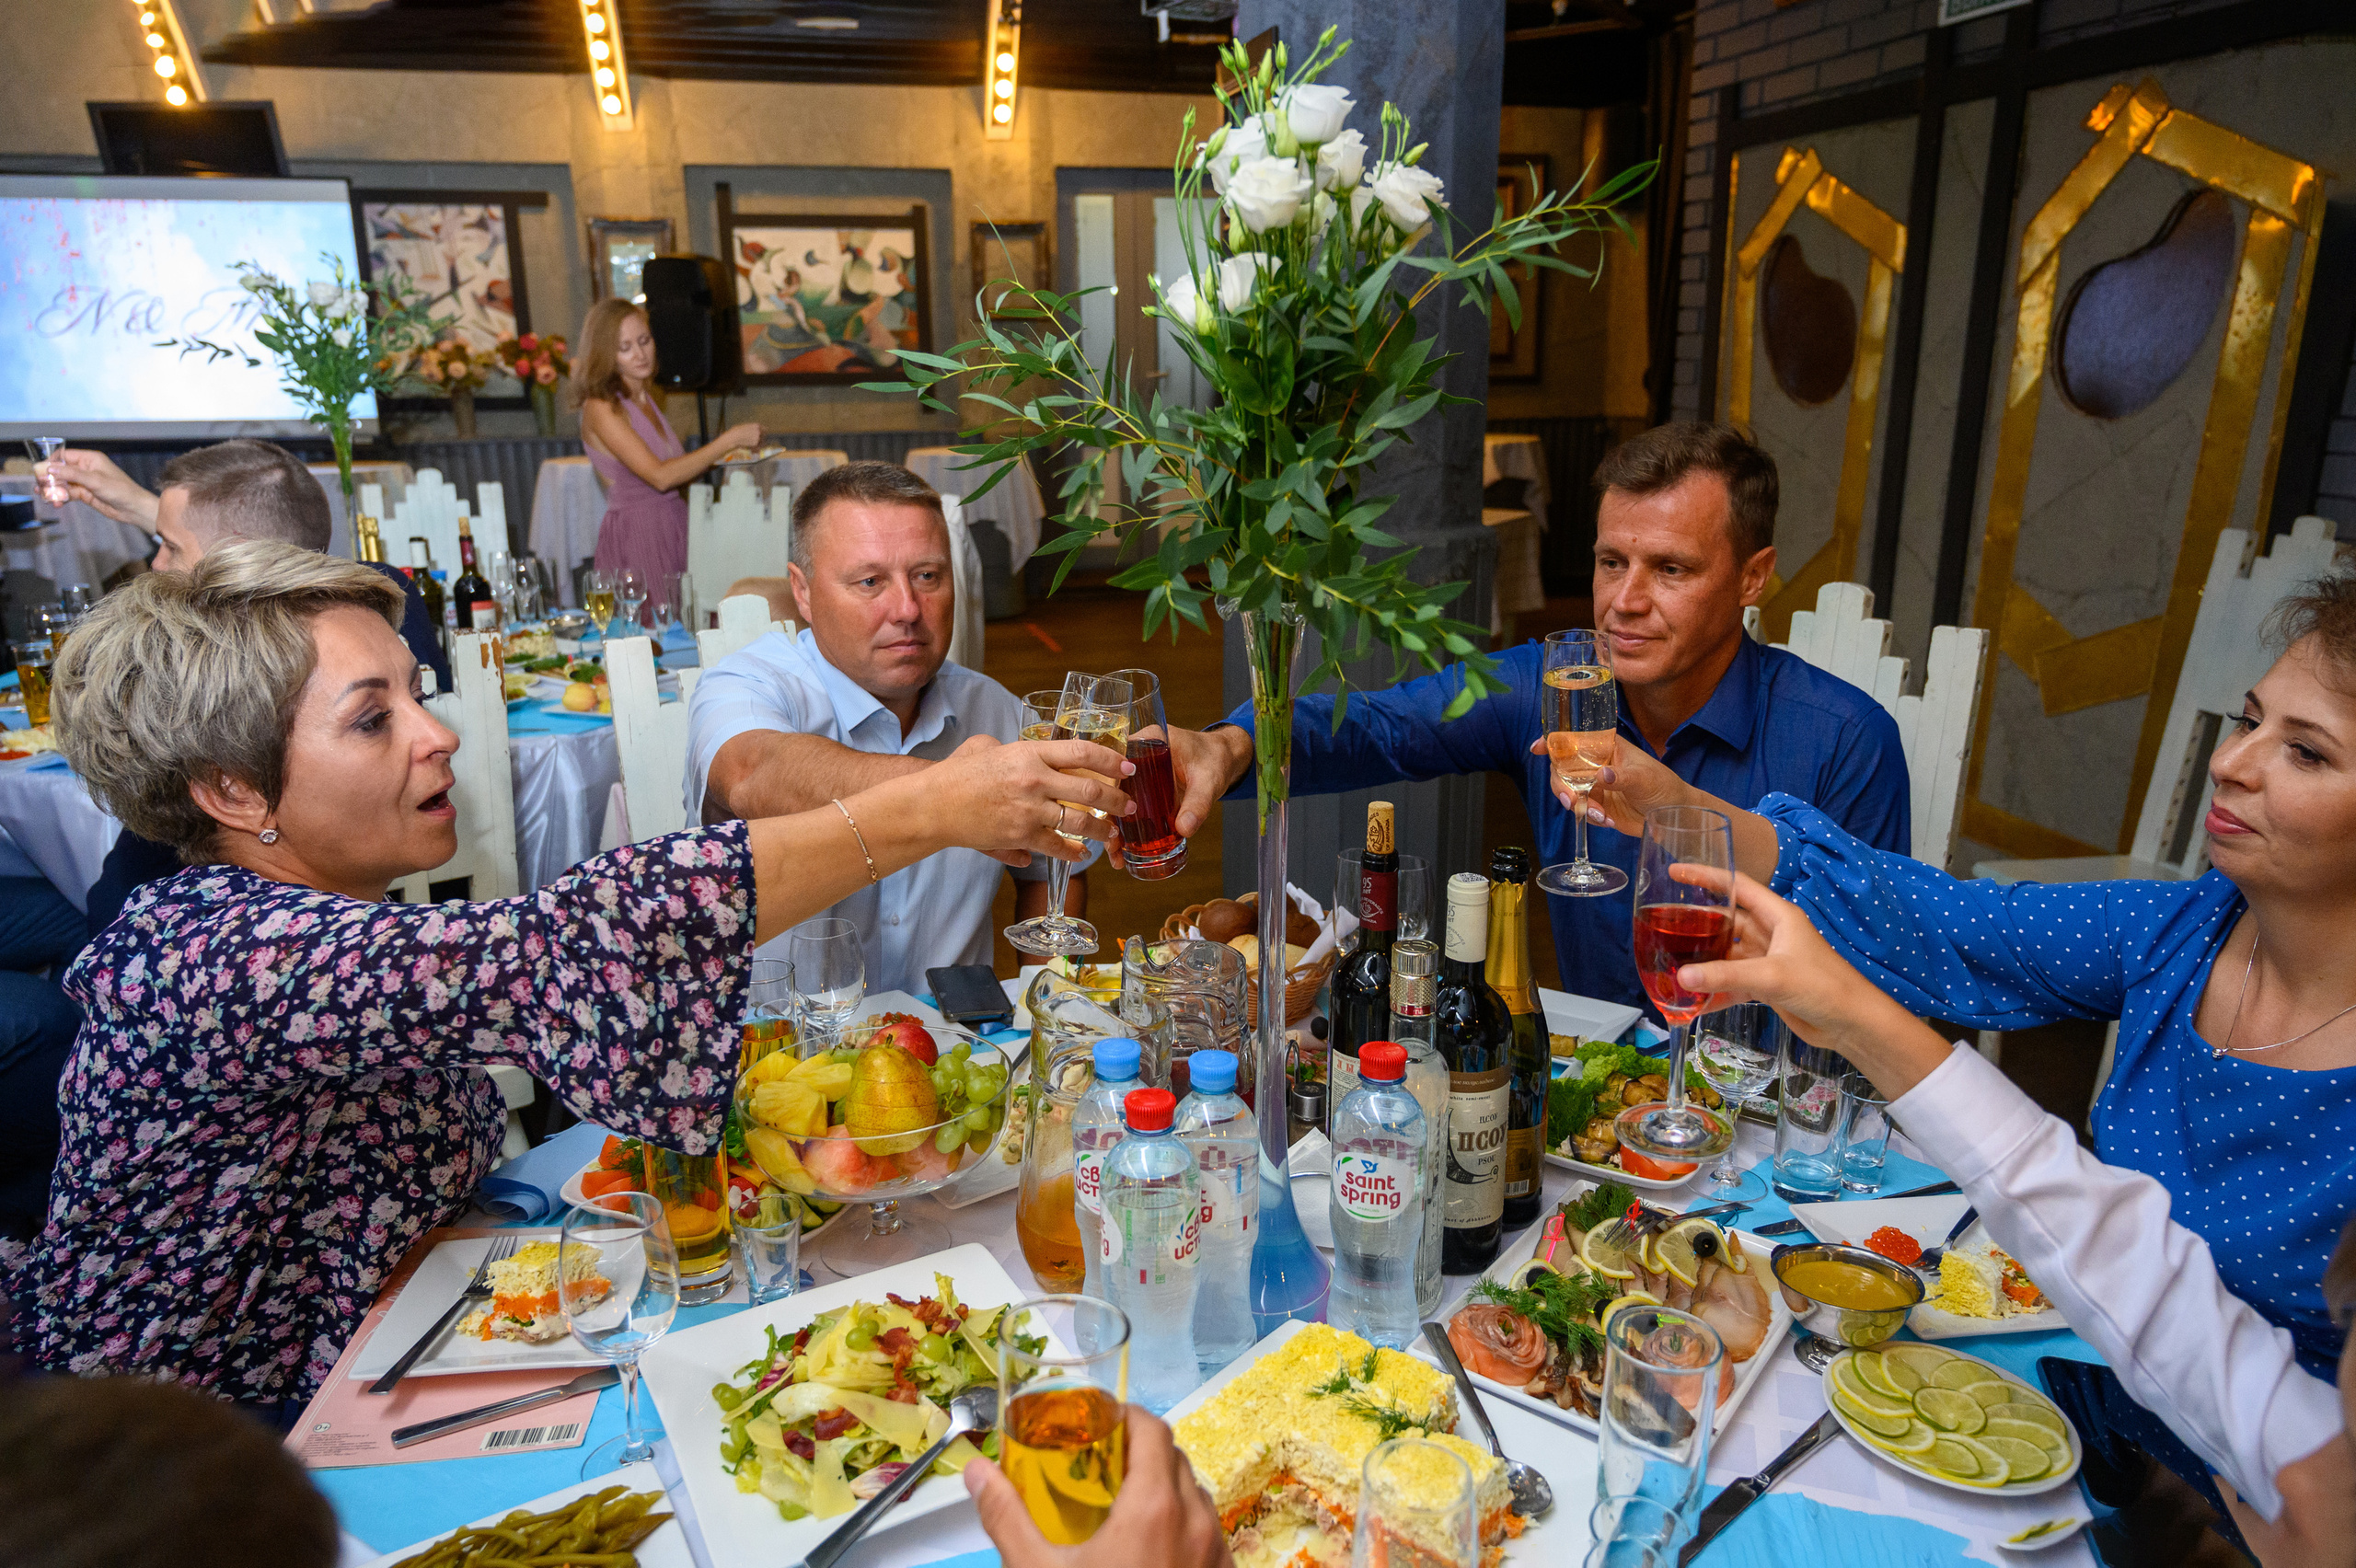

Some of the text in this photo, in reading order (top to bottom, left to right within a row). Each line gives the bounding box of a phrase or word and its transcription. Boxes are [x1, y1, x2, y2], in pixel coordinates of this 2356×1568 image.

[1362, 877, 1372, 889] 95
[1457, 1120, 1507, 1152] ПСОУ
[1478, 1154, 1496, 1166] PSOU
[1345, 1170, 1395, 1191] saint
[1340, 1183, 1401, 1210] spring
